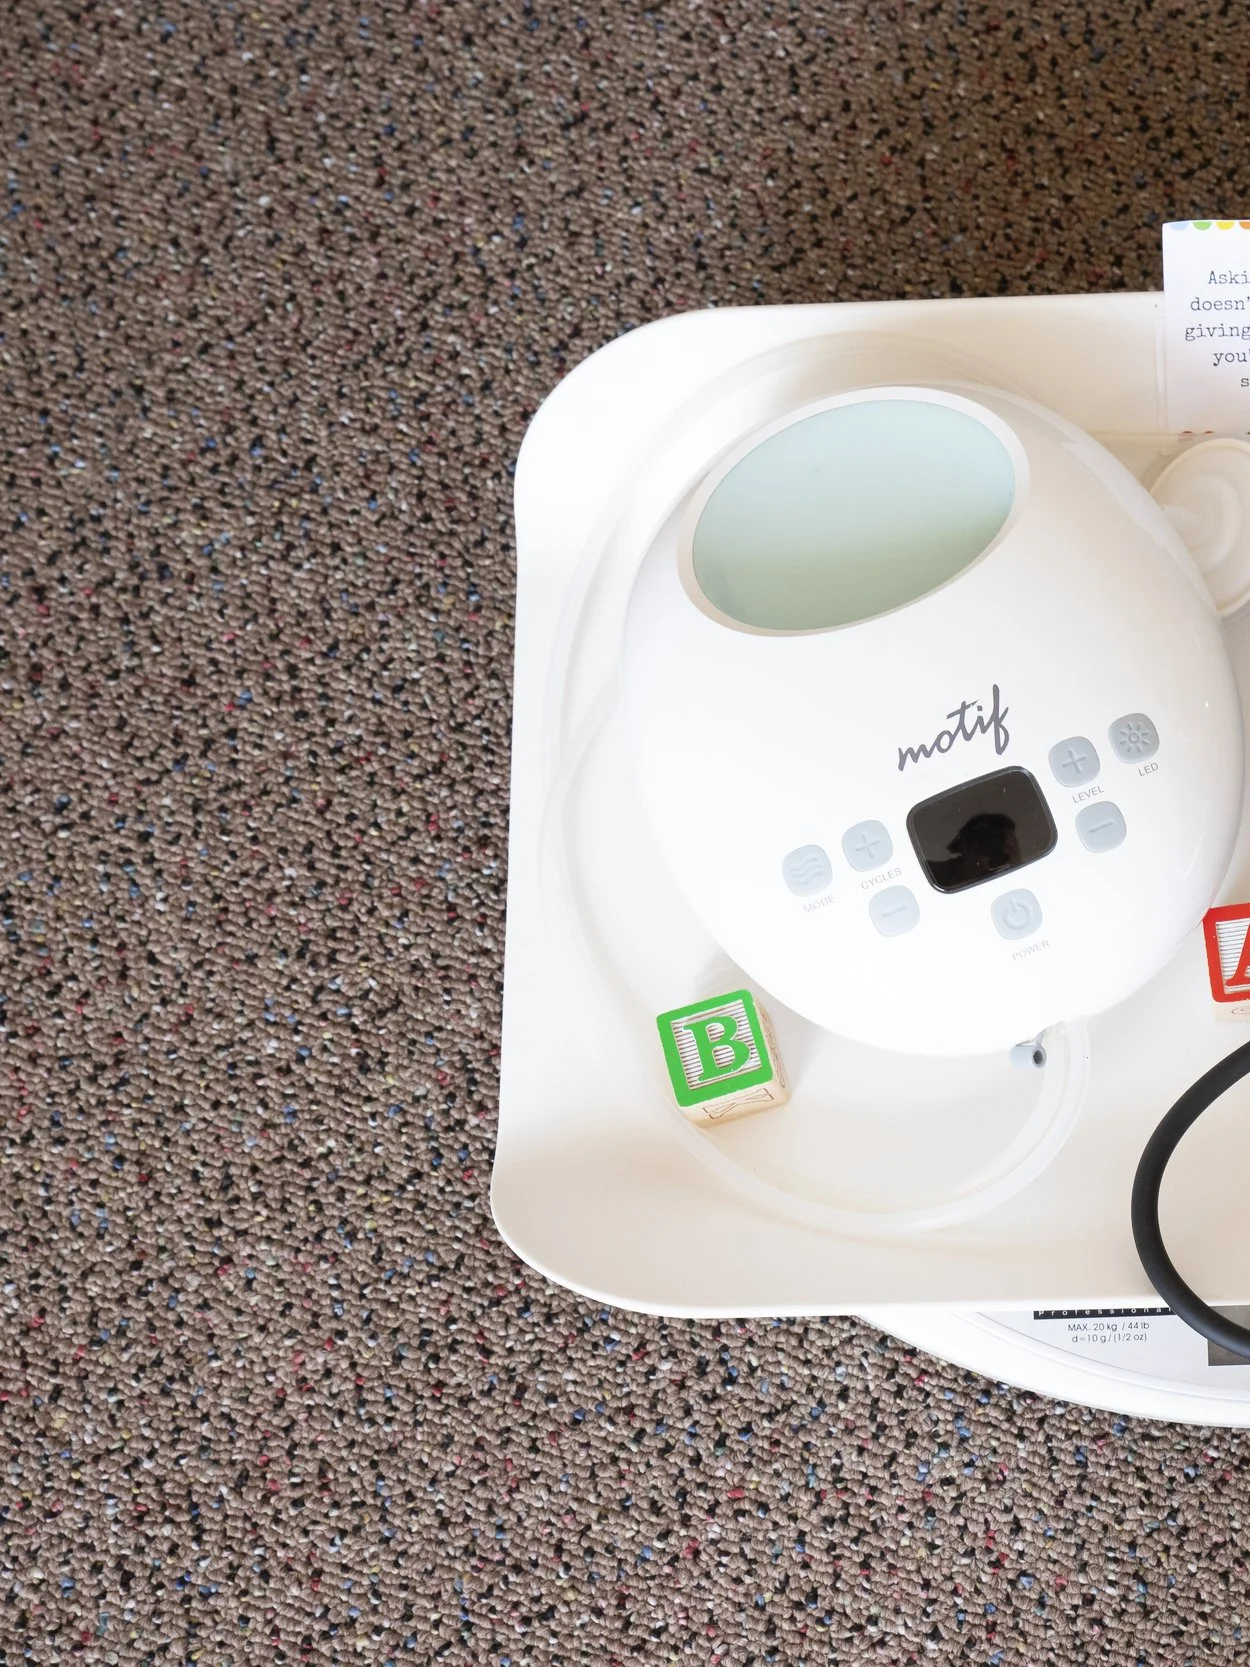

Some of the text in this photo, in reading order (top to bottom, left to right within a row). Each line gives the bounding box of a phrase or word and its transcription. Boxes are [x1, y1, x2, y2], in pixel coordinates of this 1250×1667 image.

[897, 683, 1010, 772] motif
[1138, 762, 1159, 777] LED
[1072, 785, 1105, 804] LEVEL
[861, 867, 903, 890] CYCLES
[803, 894, 835, 914] MODE
[1012, 939, 1051, 961] POWER
[682, 1015, 751, 1082] B
[1067, 1323, 1091, 1332] MAX.
[1093, 1322, 1105, 1331] 20
[1106, 1321, 1118, 1332] kg
[1127, 1321, 1139, 1330] 44
[1140, 1320, 1150, 1330] lb
